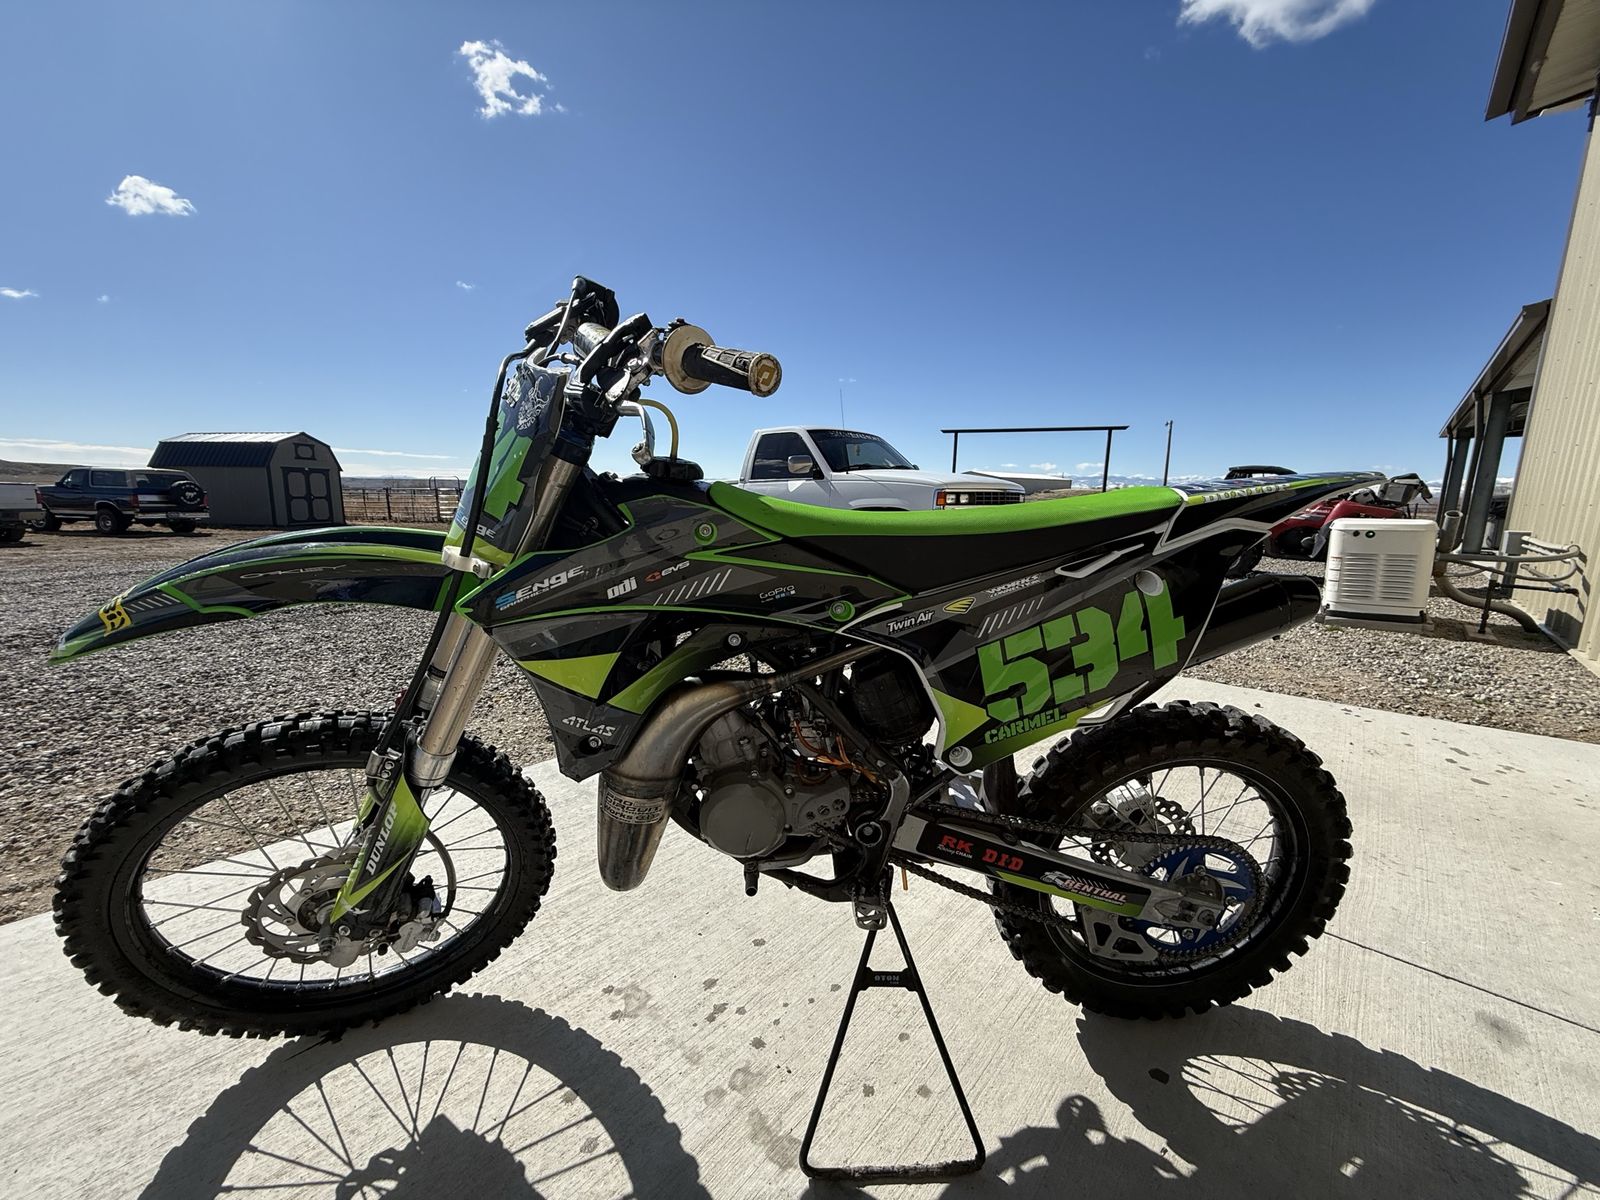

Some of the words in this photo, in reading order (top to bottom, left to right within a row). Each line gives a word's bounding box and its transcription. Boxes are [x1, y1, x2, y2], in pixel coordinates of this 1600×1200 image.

[759, 585, 796, 600] GoPro
[887, 616, 916, 634] Twin
[916, 610, 936, 625] Air
[976, 581, 1186, 724] 534
[561, 715, 617, 737] ATLAS
[983, 708, 1067, 745] CARMEL
[365, 800, 398, 876] DUNLOP
[941, 834, 975, 853] RK
[1063, 879, 1128, 902] RENTHAL
